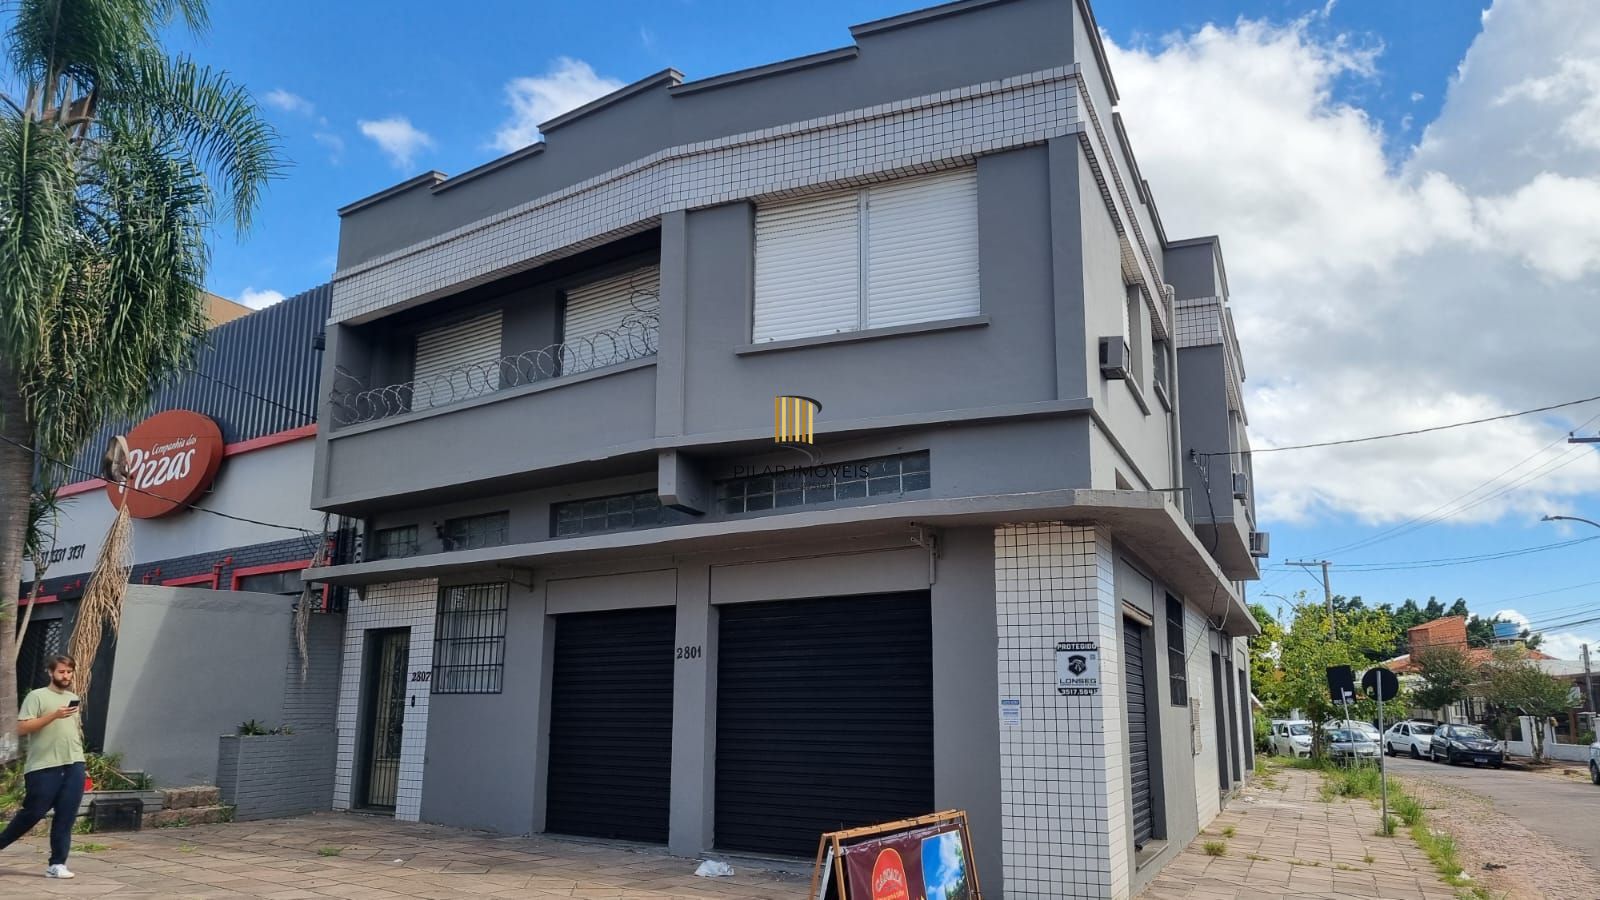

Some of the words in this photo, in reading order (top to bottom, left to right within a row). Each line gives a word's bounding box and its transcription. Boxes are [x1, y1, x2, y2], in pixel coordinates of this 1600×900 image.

[67, 543, 86, 560] 3131
[676, 645, 702, 660] 2801
[411, 670, 432, 682] 2807
